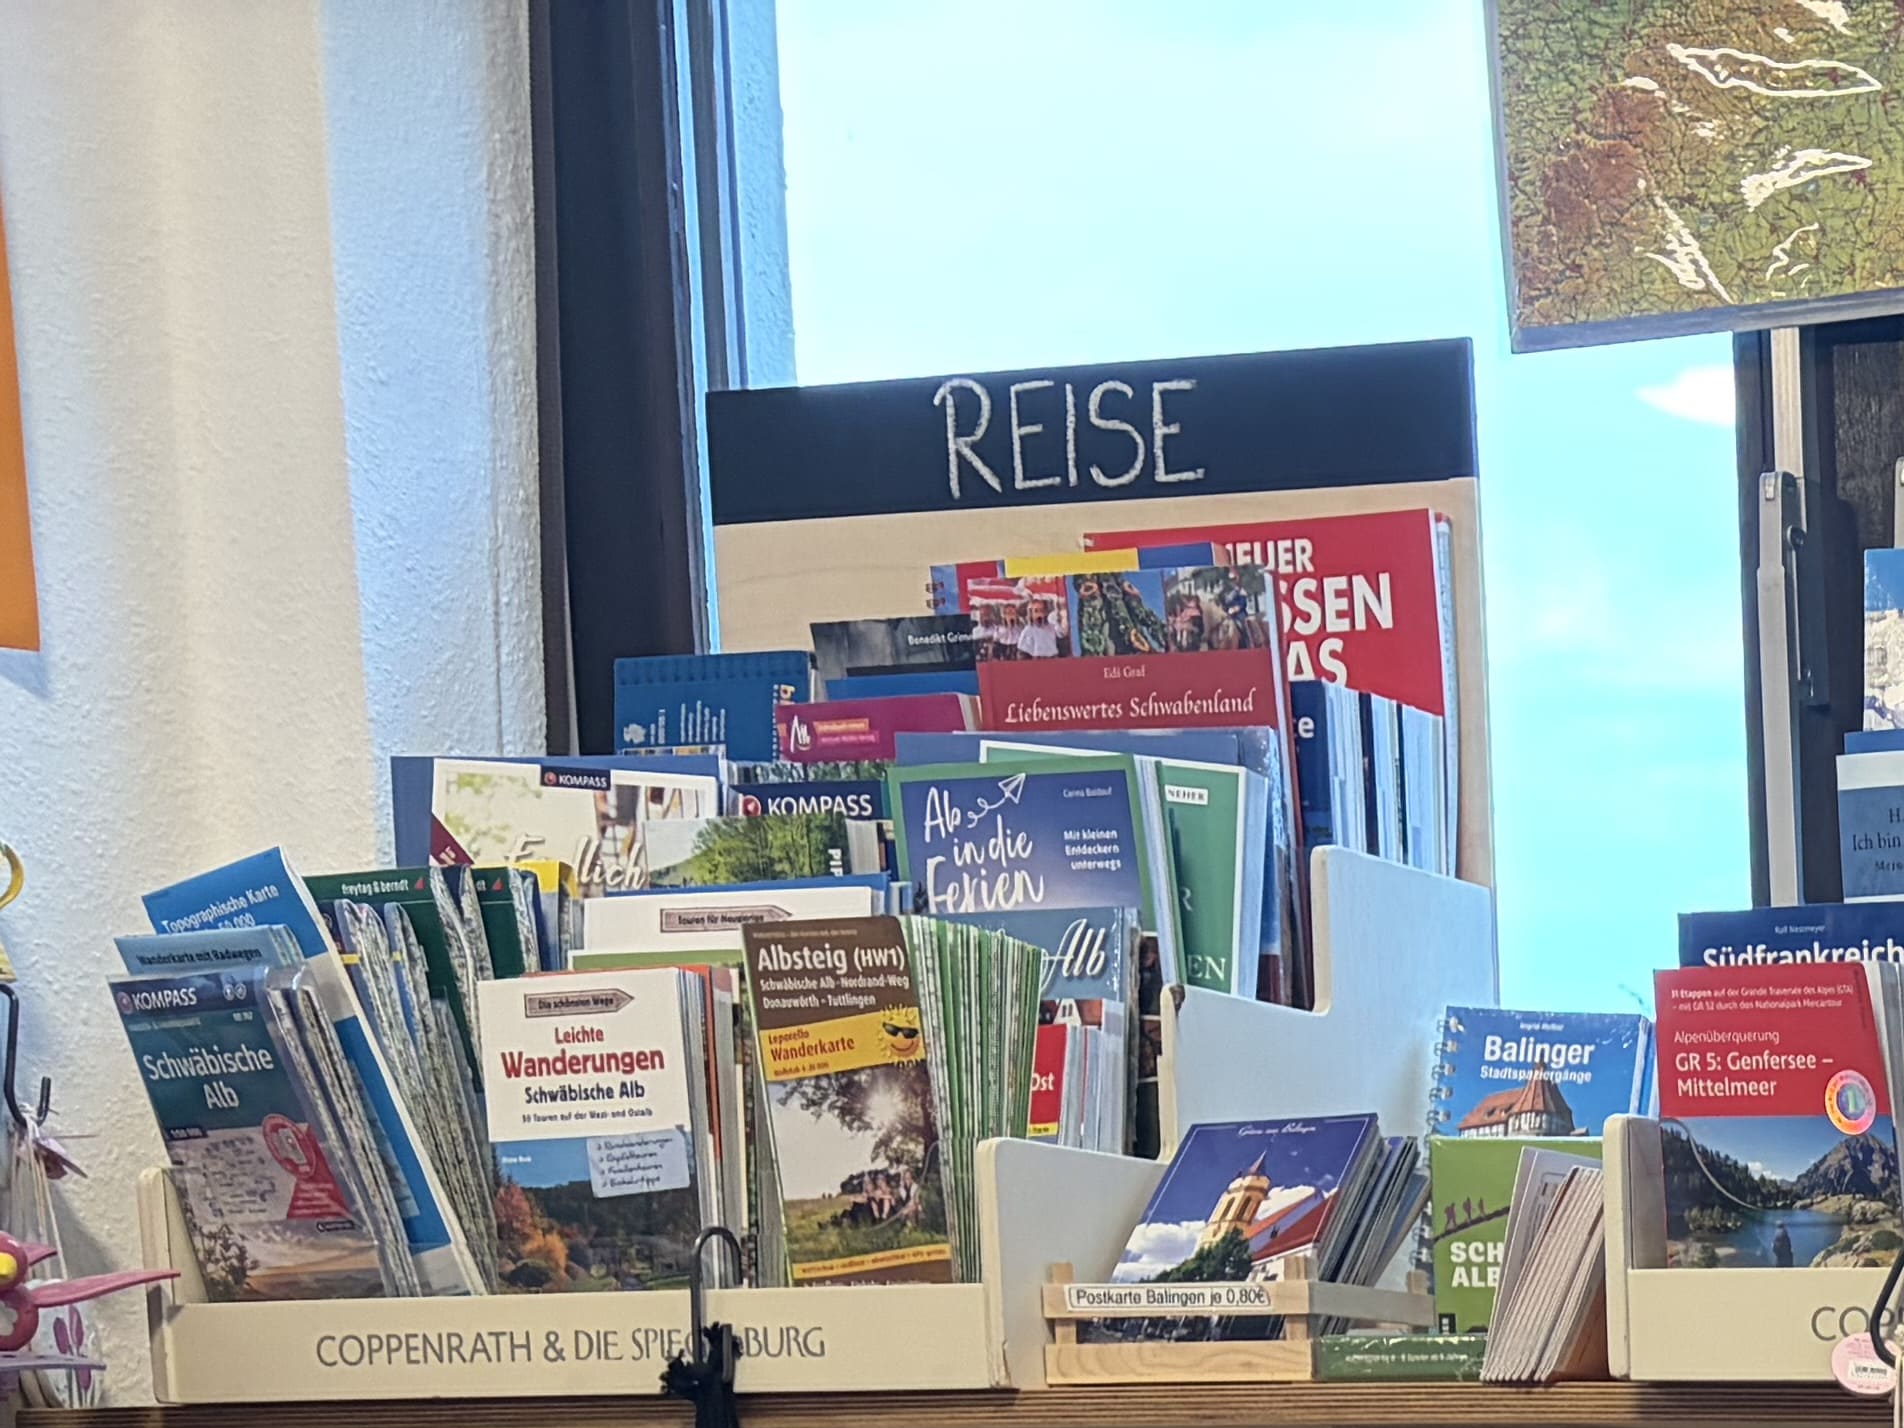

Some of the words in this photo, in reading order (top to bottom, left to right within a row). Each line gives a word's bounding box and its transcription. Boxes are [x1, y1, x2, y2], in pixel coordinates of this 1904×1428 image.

[932, 378, 1206, 500] REISE
[1004, 693, 1125, 725] Liebenswertes
[1129, 688, 1255, 719] Schwabenland
[558, 772, 608, 790] KOMPASS
[767, 794, 874, 818] KOMPASS
[924, 786, 962, 843] Ab
[953, 837, 985, 869] in
[988, 813, 1033, 867] die
[1852, 832, 1875, 854] Ich
[1876, 830, 1902, 850] bin
[926, 855, 1044, 914] Ferien
[757, 943, 848, 975] Albsteig
[853, 945, 906, 973] (HW1)
[131, 987, 198, 1011] KOMPASS
[554, 1025, 605, 1045] Leichte
[770, 1035, 856, 1063] Wanderkarte
[1674, 1030, 1781, 1046] Alpenüberquerung
[142, 1043, 275, 1082] Schwäbische
[500, 1048, 666, 1079] Wanderungen
[1483, 1034, 1596, 1068] Balinger
[1675, 1053, 1701, 1072] GR
[1706, 1052, 1722, 1071] 5:
[1726, 1050, 1817, 1070] Genfersee
[1479, 1063, 1593, 1086] Stadtspaziergänge
[1677, 1078, 1777, 1097] Mittelmeer
[202, 1080, 240, 1110] Alb
[524, 1082, 614, 1105] Schwäbische
[618, 1079, 646, 1100] Alb
[1075, 1287, 1142, 1306] Postkarte
[1145, 1287, 1206, 1309] Balingen
[1225, 1287, 1267, 1305] 0,80€
[315, 1329, 532, 1369] COPPENRATH
[543, 1330, 566, 1362] &
[573, 1327, 624, 1361] DIE
